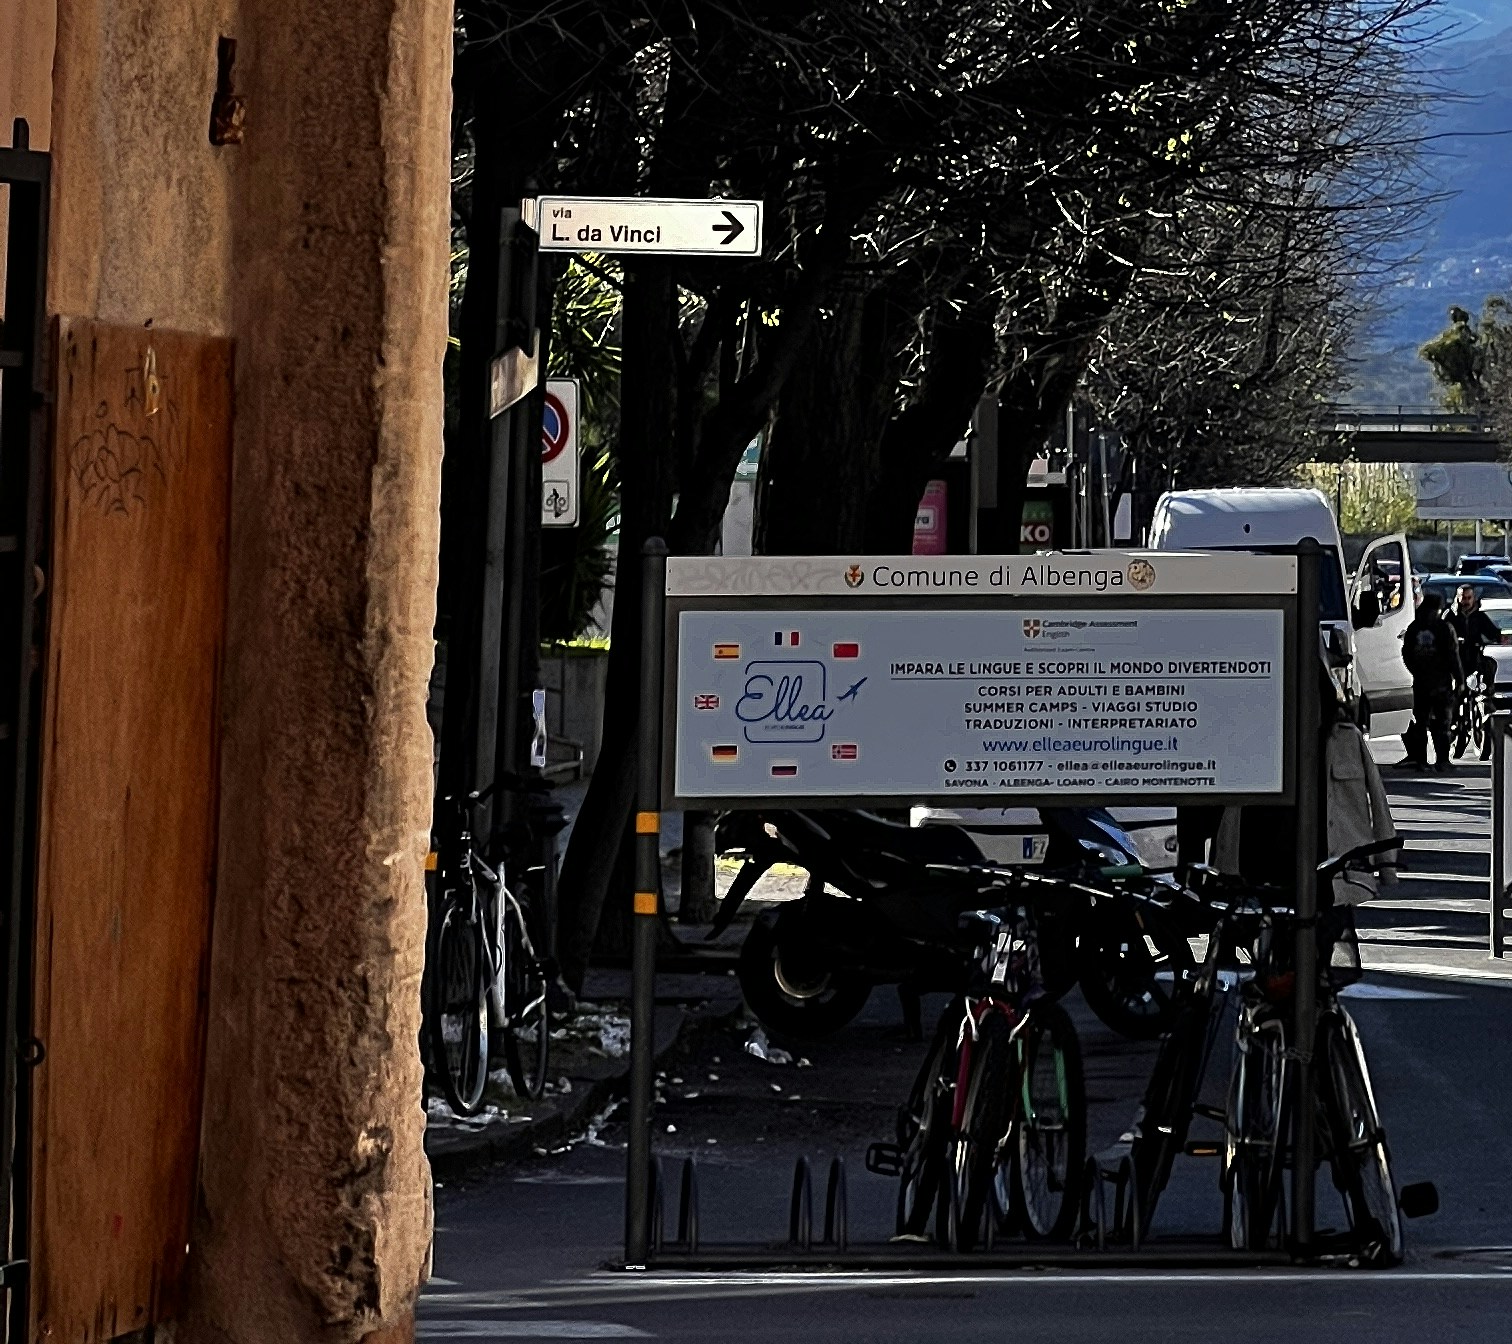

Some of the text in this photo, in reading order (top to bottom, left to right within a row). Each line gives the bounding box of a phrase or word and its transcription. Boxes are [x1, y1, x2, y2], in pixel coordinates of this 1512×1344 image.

[552, 208, 571, 218] via
[552, 224, 661, 244] L. da Vinci
[873, 564, 1123, 591] Comune di Albenga
[890, 661, 1271, 675] IMPARA LE LINGUE E SCOPRI IL MONDO DIVERTENDOTI
[978, 684, 1185, 697] CORSI PER ADULTI E BAMBINI
[735, 674, 834, 723] Ellea
[964, 702, 1025, 713] SUMMER
[1028, 702, 1078, 713] CAMPS
[1091, 701, 1141, 713] VIAGGI
[1145, 701, 1198, 712] STUDIO
[964, 719, 1054, 730] TRADUZIONI
[1067, 717, 1198, 730] INTERPRETARIATO
[982, 735, 1178, 755] www.elleaeurolingue.it
[965, 760, 989, 772] 337
[993, 760, 1044, 772] 1061177
[1056, 759, 1216, 773] ellea@elleaeurolingue.it
[944, 778, 989, 788] SAVONA
[1056, 778, 1096, 787] LOANO
